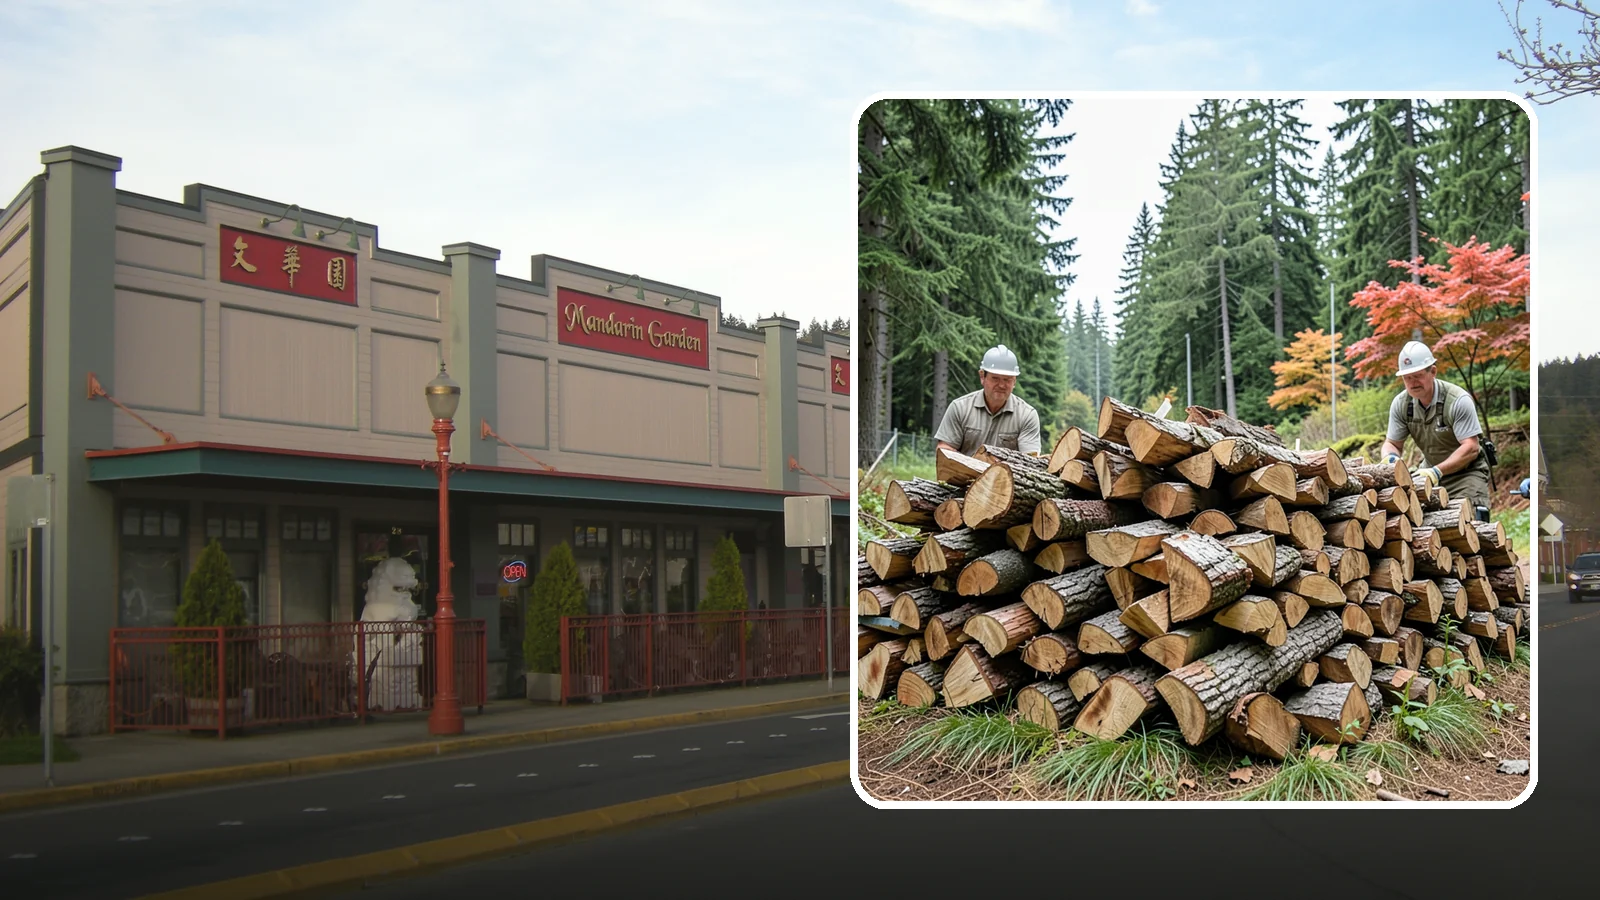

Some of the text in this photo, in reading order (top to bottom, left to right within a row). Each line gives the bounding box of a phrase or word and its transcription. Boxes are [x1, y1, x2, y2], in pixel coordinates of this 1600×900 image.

[231, 235, 346, 290] 文華園
[564, 302, 702, 352] Mandarin Garden
[503, 565, 527, 578] OPEN
